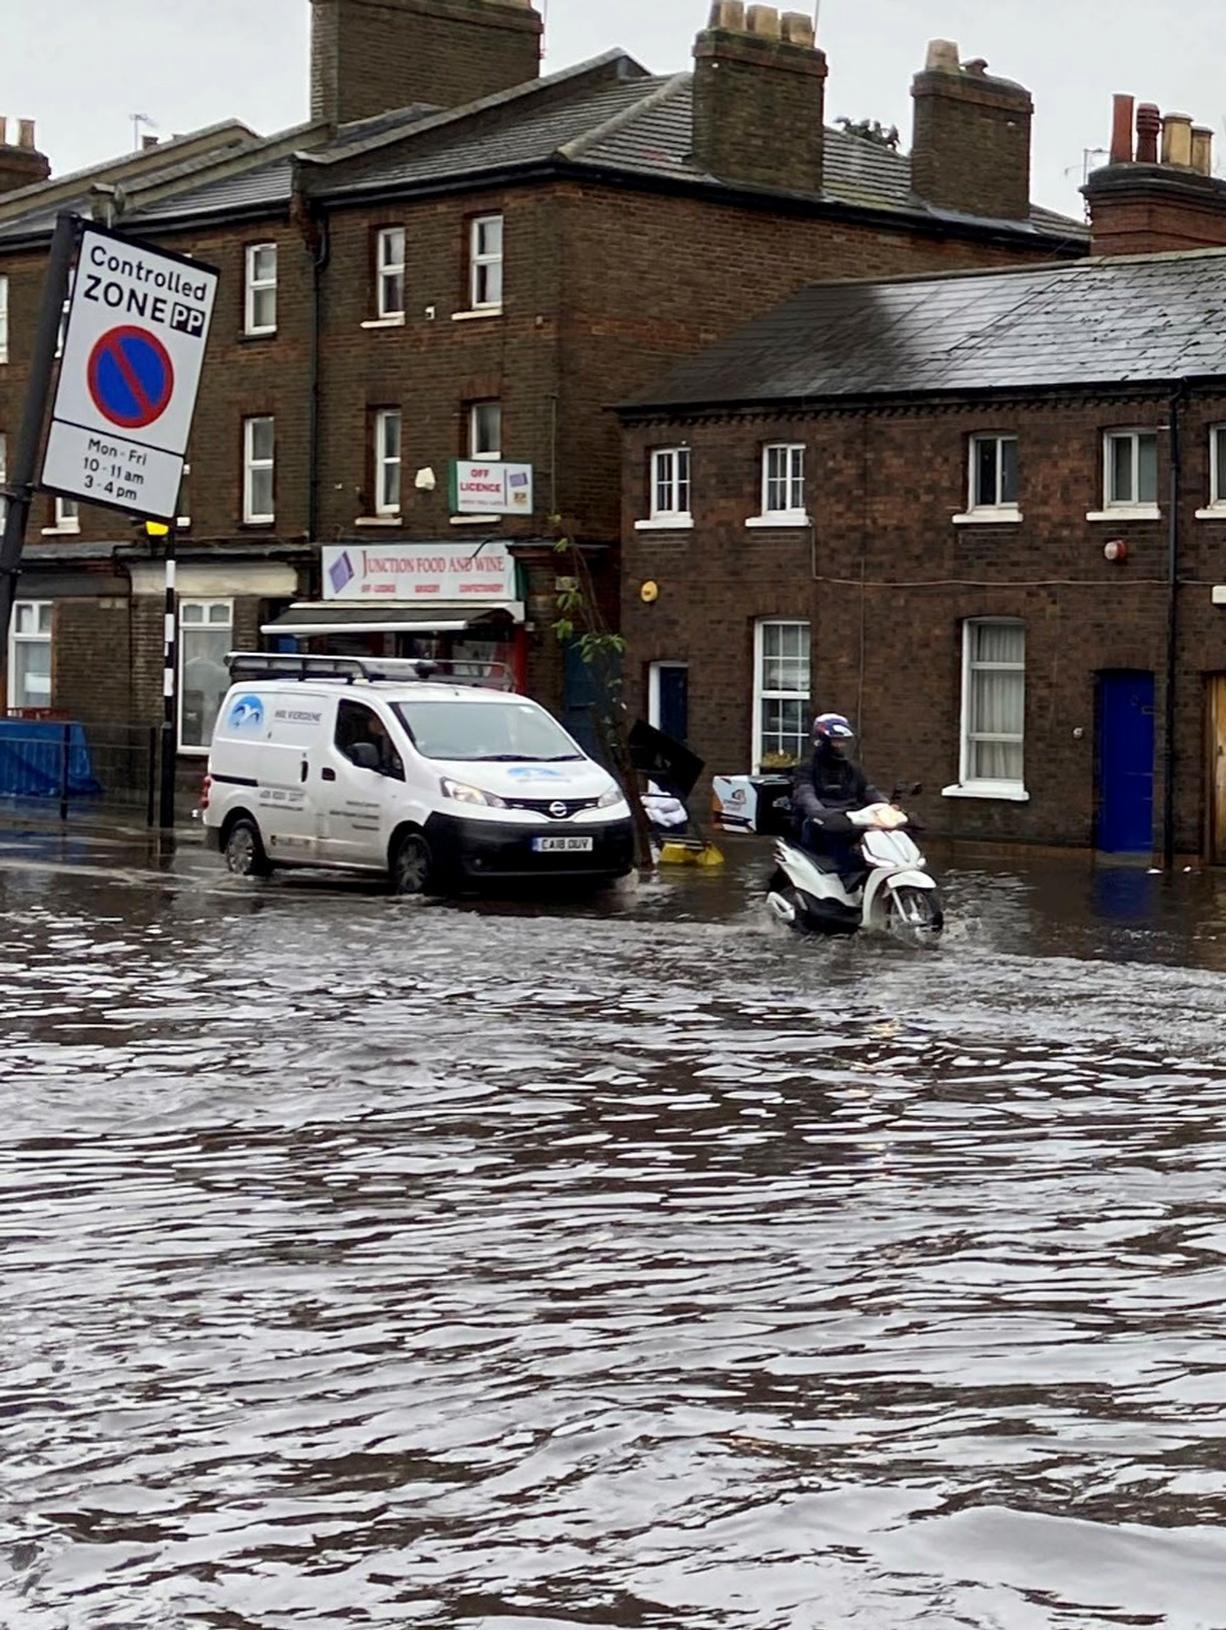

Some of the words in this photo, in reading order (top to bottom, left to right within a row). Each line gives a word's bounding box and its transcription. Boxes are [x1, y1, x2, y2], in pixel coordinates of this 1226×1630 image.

[91, 246, 207, 302] Controlled
[84, 274, 167, 323] ZONE
[171, 303, 204, 334] PP
[88, 438, 117, 458] Mon
[128, 450, 147, 466] Fri
[84, 457, 99, 472] 10
[84, 475, 94, 489] 3
[460, 482, 501, 493] LICENCE
[416, 557, 446, 573] FOOD
[450, 556, 472, 572] AND
[473, 556, 504, 572] WINE
